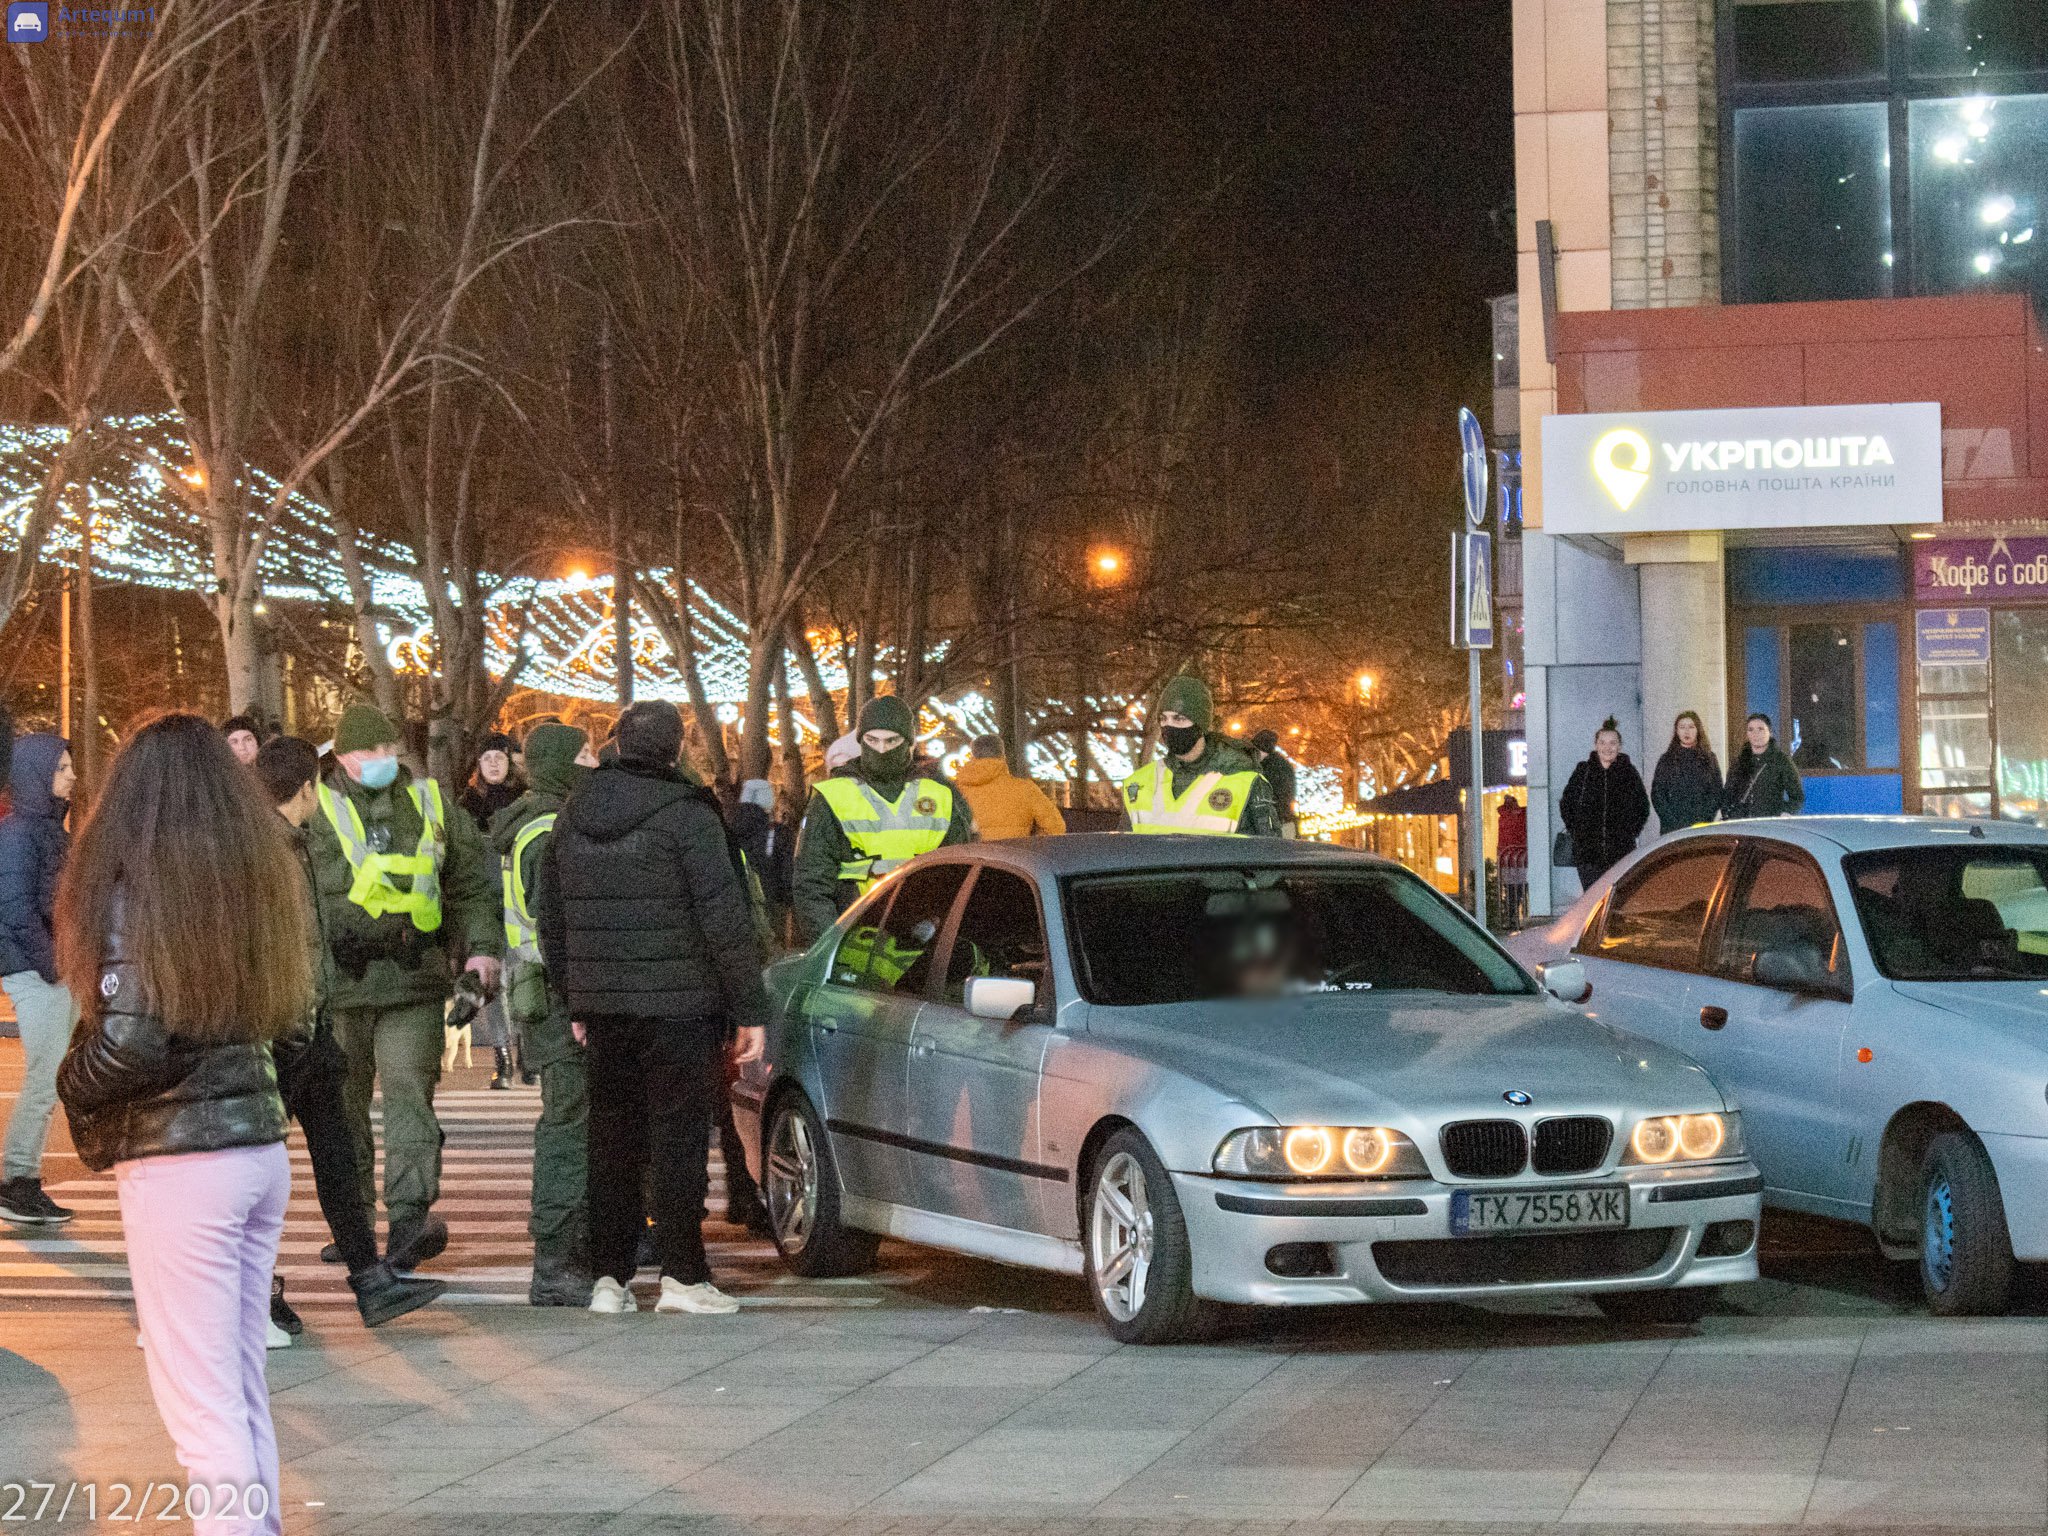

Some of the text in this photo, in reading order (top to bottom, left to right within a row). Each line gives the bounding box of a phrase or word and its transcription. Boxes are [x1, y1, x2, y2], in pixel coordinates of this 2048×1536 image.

[1662, 435, 1895, 473] УКРПОШТА
[1666, 474, 1896, 495] ГОЛОВНА ПОШТА КРАЇНИ
[1930, 556, 1989, 595] Кофе
[1995, 563, 2007, 585] с
[1473, 1191, 1621, 1226] TX 7558 XK
